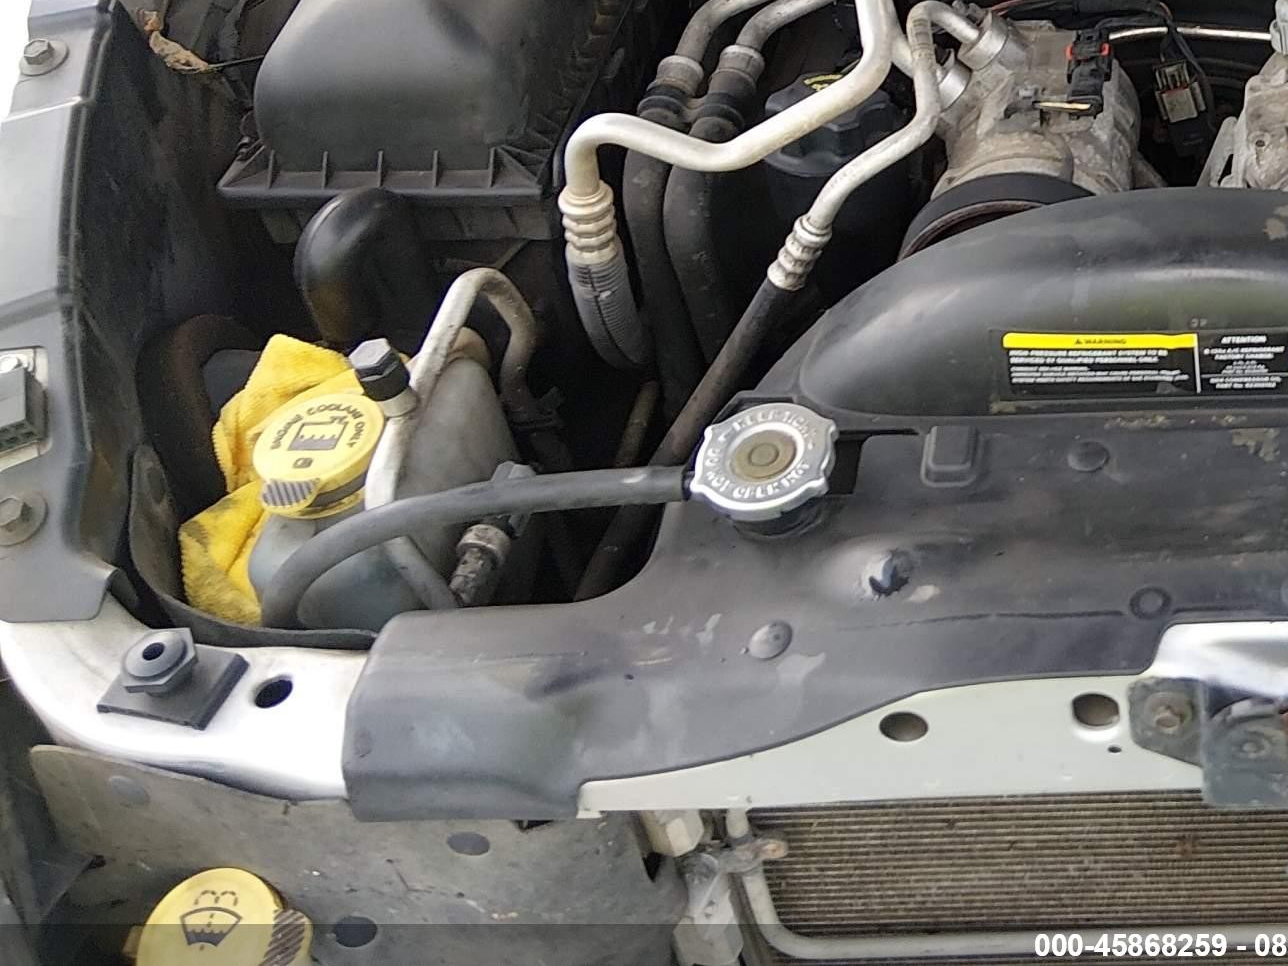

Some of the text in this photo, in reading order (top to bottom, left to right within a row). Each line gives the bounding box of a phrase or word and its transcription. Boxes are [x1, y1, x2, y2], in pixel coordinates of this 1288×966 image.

[1221, 335, 1268, 344] ATTENTION
[306, 403, 365, 420] COOLANT
[347, 421, 366, 448] ONLY
